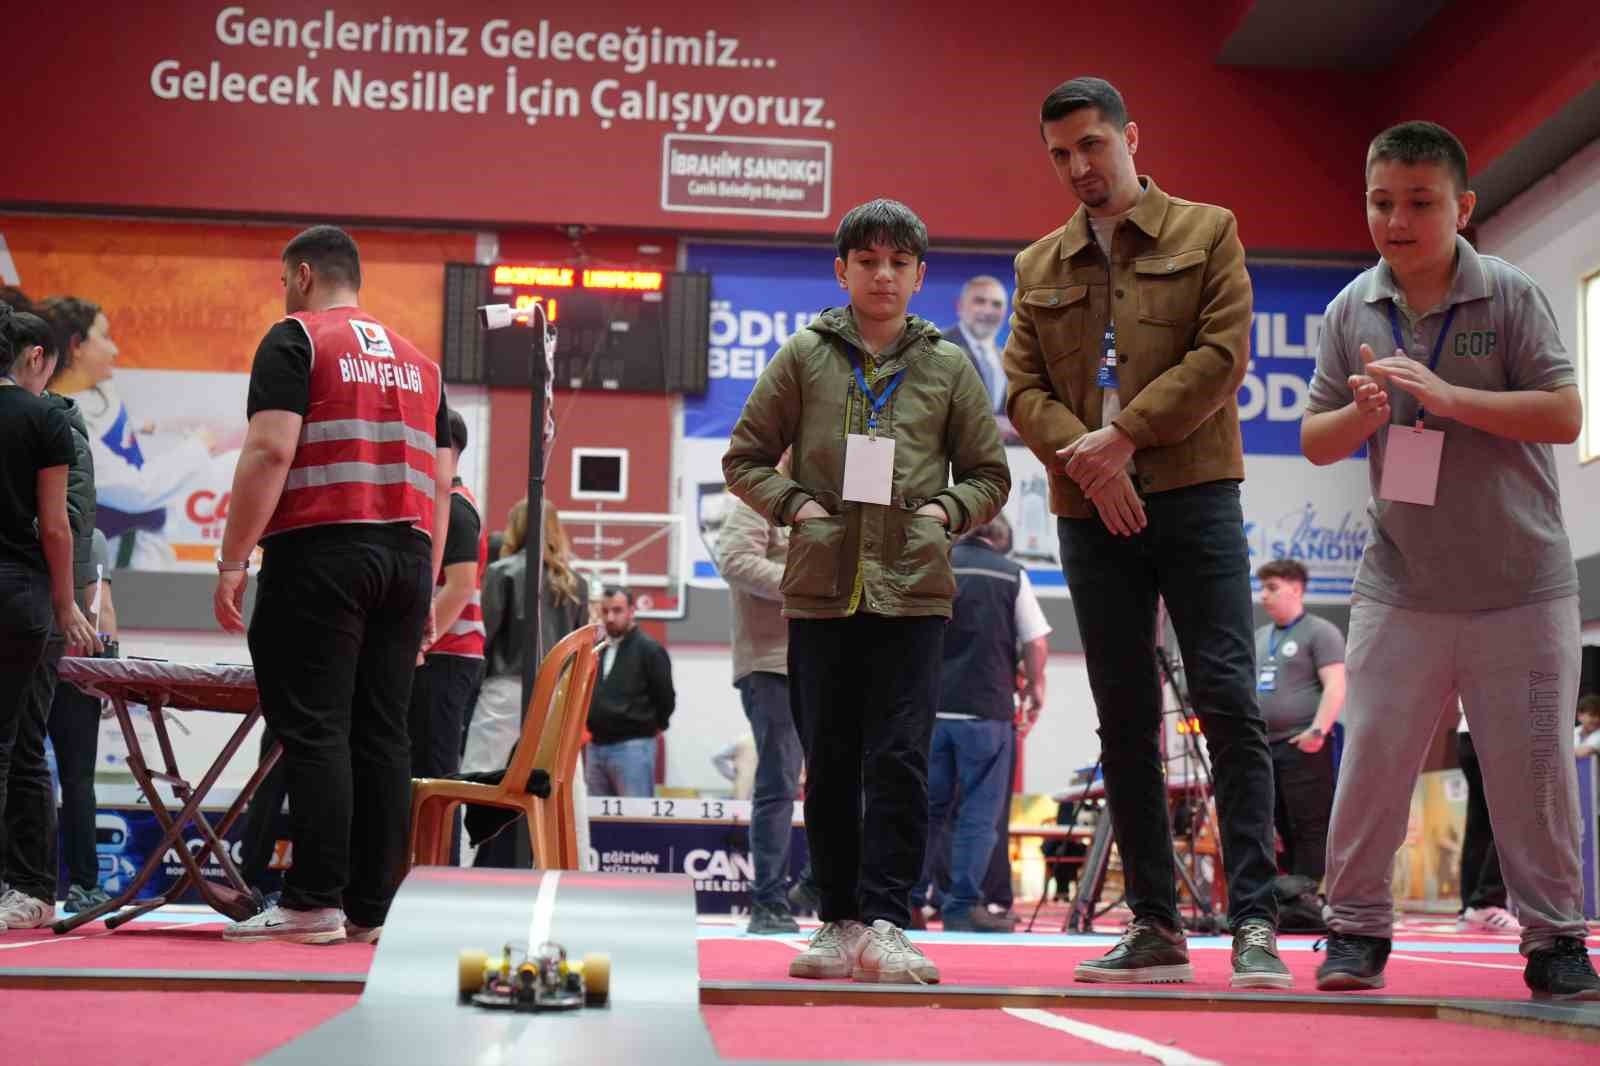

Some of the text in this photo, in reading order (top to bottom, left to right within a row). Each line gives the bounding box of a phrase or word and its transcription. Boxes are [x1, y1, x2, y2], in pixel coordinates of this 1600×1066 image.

[215, 7, 777, 73] Gençlerimiz Geleceğimiz...
[150, 60, 836, 133] Gelecek Nesiller İçin Çalışıyoruz.
[670, 149, 824, 186] İBRAHİM SANDIKÇI
[339, 352, 378, 384] BİLİM
[602, 799, 724, 819] 11 12 13
